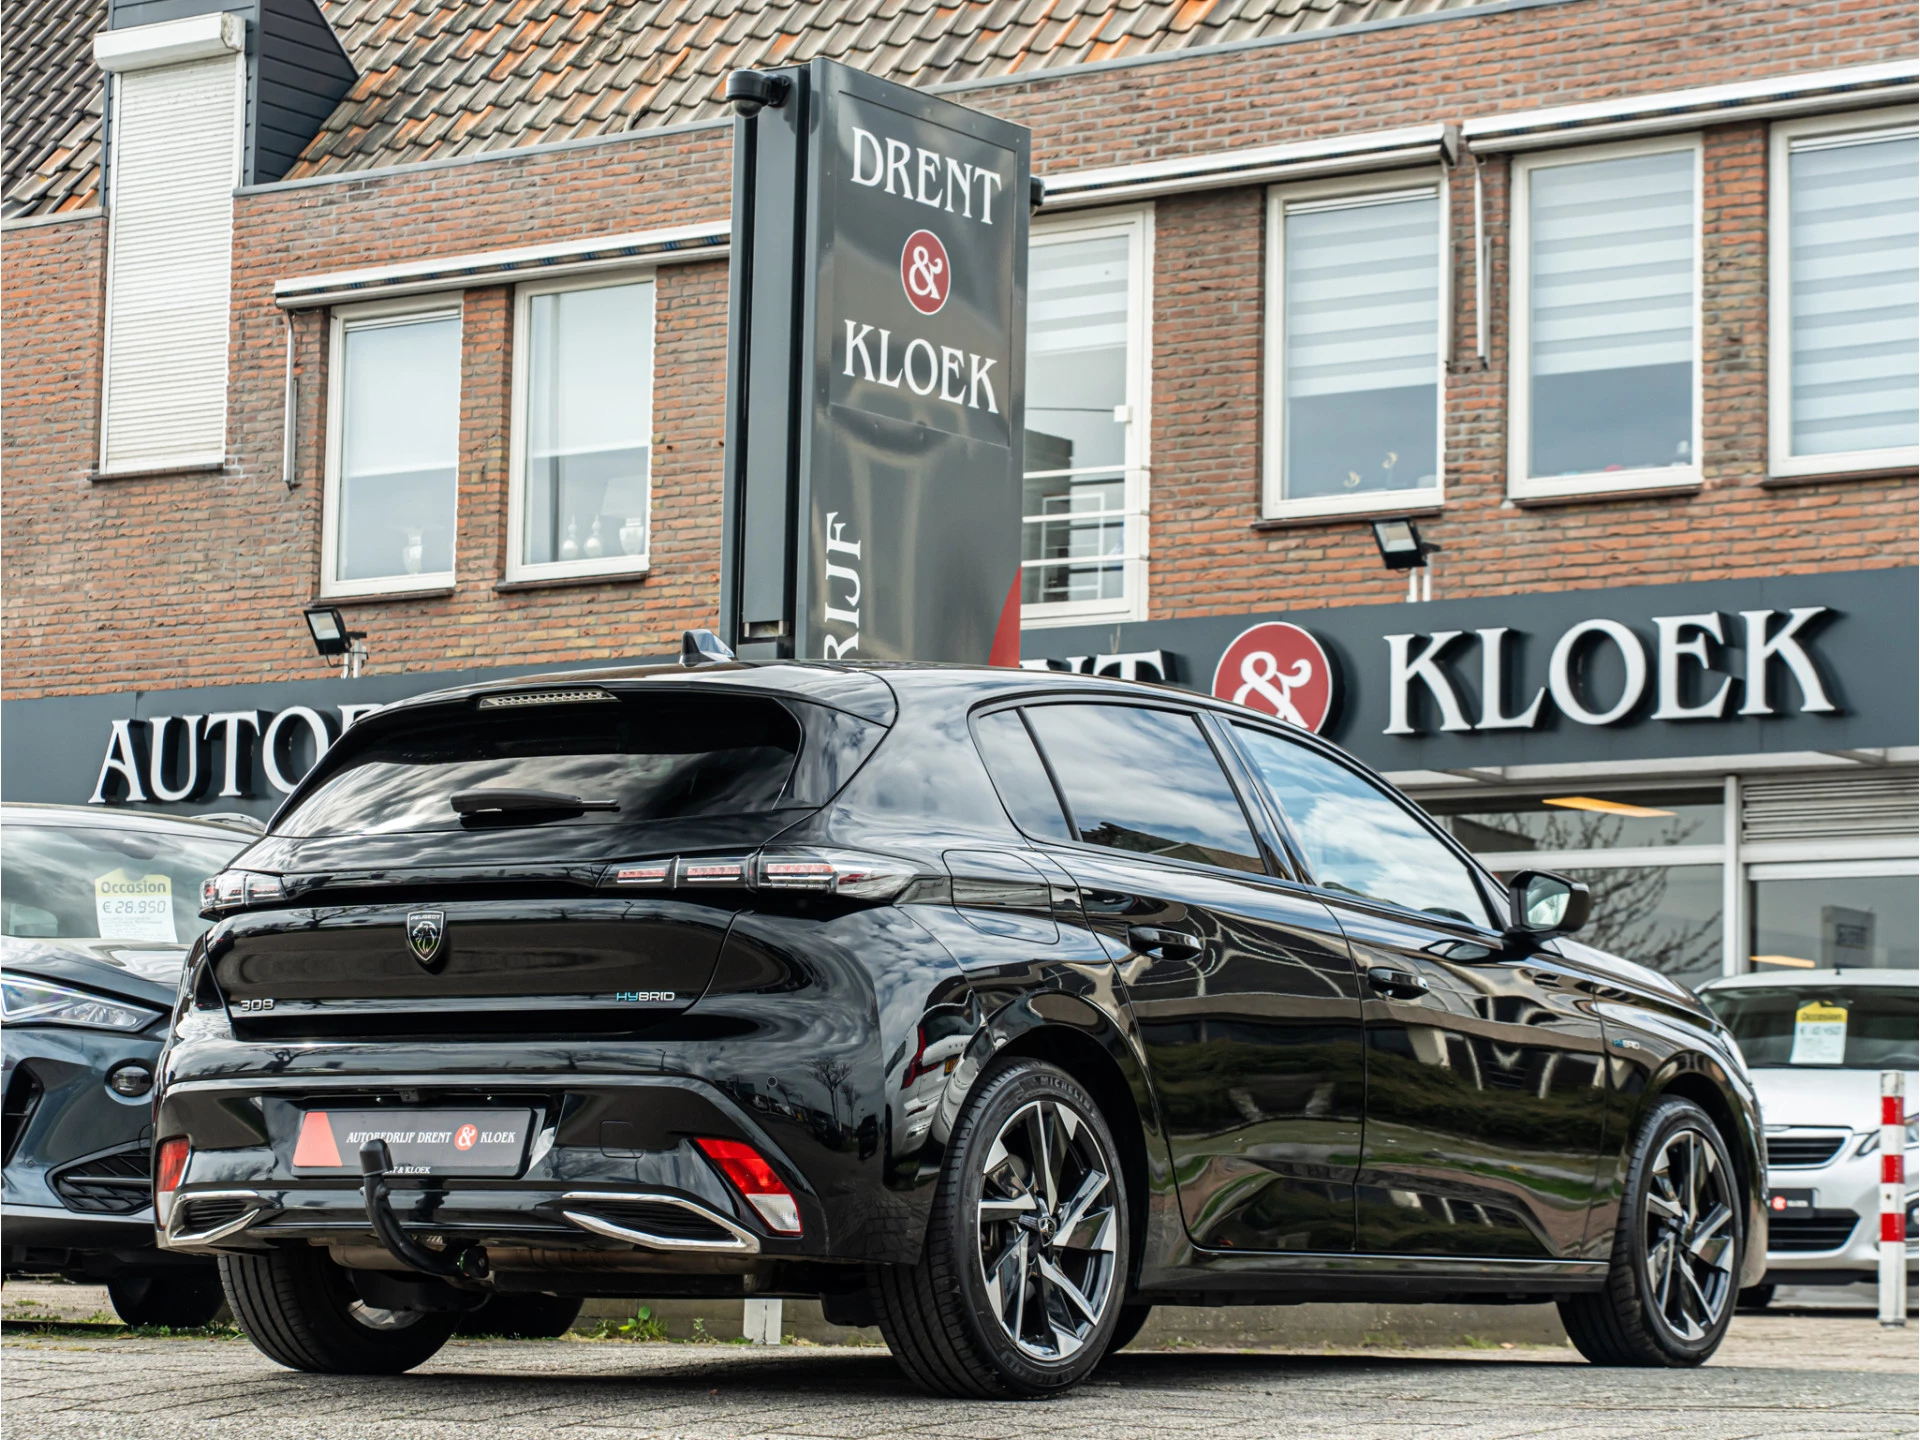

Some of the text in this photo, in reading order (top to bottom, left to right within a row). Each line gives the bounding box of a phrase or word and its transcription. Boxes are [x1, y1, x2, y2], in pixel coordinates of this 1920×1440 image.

[850, 126, 1001, 225] DRENT
[909, 246, 943, 300] &
[842, 319, 1000, 414] KLOEK
[1382, 606, 1836, 735] KLOEK
[101, 881, 167, 893] Occasion
[240, 998, 274, 1011] 308
[616, 991, 675, 1002] HYBRID
[1040, 1075, 1092, 1110] MICHELIN
[346, 1126, 516, 1147] AUTOBEDRIJF DRENT & KLOEK
[404, 1166, 431, 1174] KLOEK
